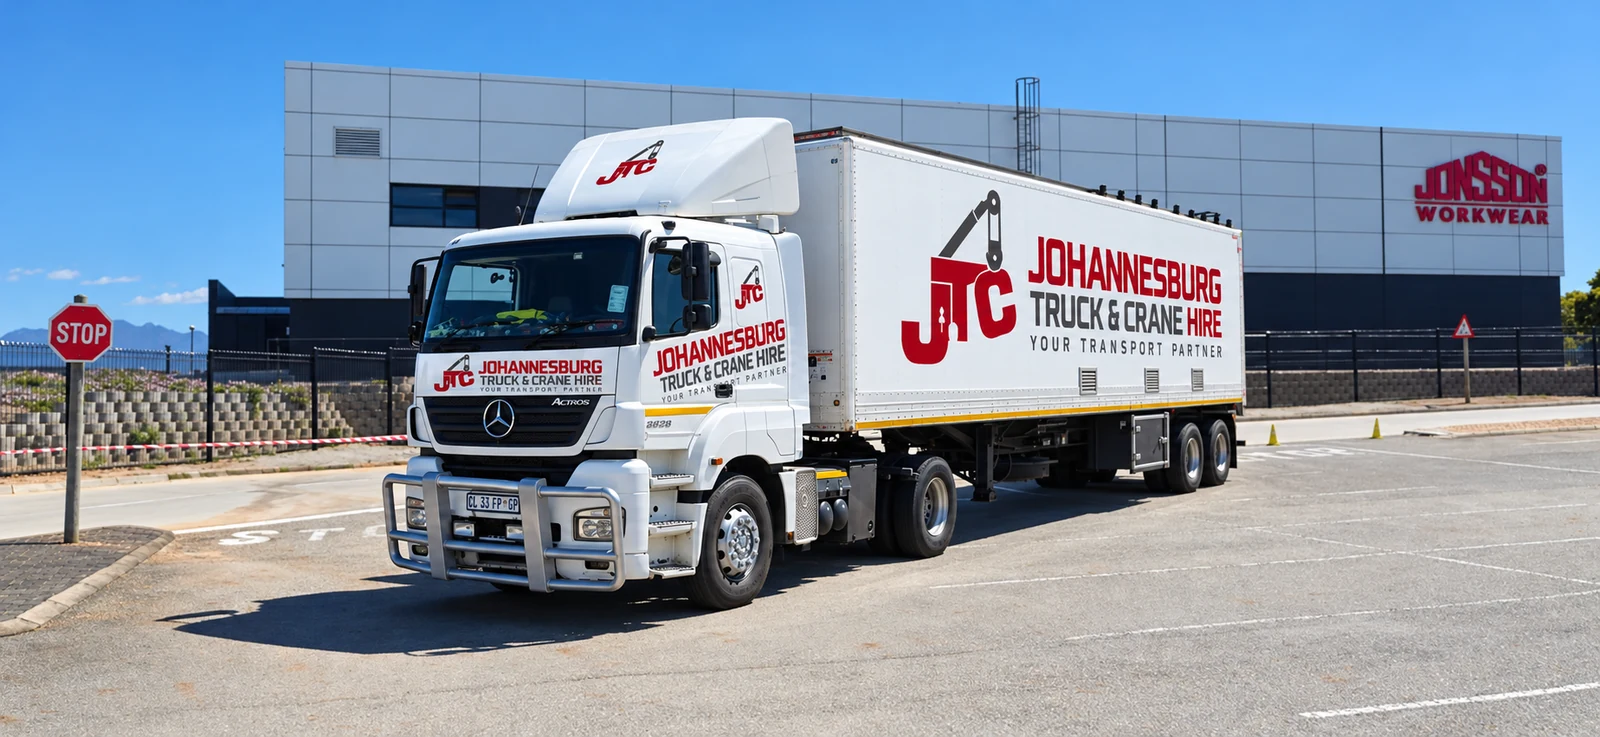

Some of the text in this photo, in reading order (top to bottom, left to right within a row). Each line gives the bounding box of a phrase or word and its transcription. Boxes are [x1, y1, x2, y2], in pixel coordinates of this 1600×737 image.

[596, 158, 658, 185] JTC
[1414, 150, 1548, 203] JONSSON
[1415, 206, 1549, 225] WORKWEAR
[1028, 236, 1222, 304] JOHANNESBURG
[734, 284, 764, 310] JTC
[900, 256, 1017, 365] JTC
[1030, 291, 1222, 338] TRUCK & CRANE HIRE
[56, 321, 107, 345] STOP
[653, 319, 786, 377] JOHANNESBURG
[1030, 335, 1222, 358] YOUR TRANSPORT PARTNER
[478, 360, 603, 375] JOHANNESBURG
[480, 375, 603, 386] TRUCK & CRANE HIRE
[660, 366, 702, 393] TRUCK
[704, 364, 712, 381] &
[713, 352, 754, 379] CRANE
[756, 343, 786, 367] HIRE
[434, 371, 474, 392] JTC
[661, 366, 787, 403] YOUR TRANSORT PARTNER
[468, 496, 518, 510] CL 33 FP GP
